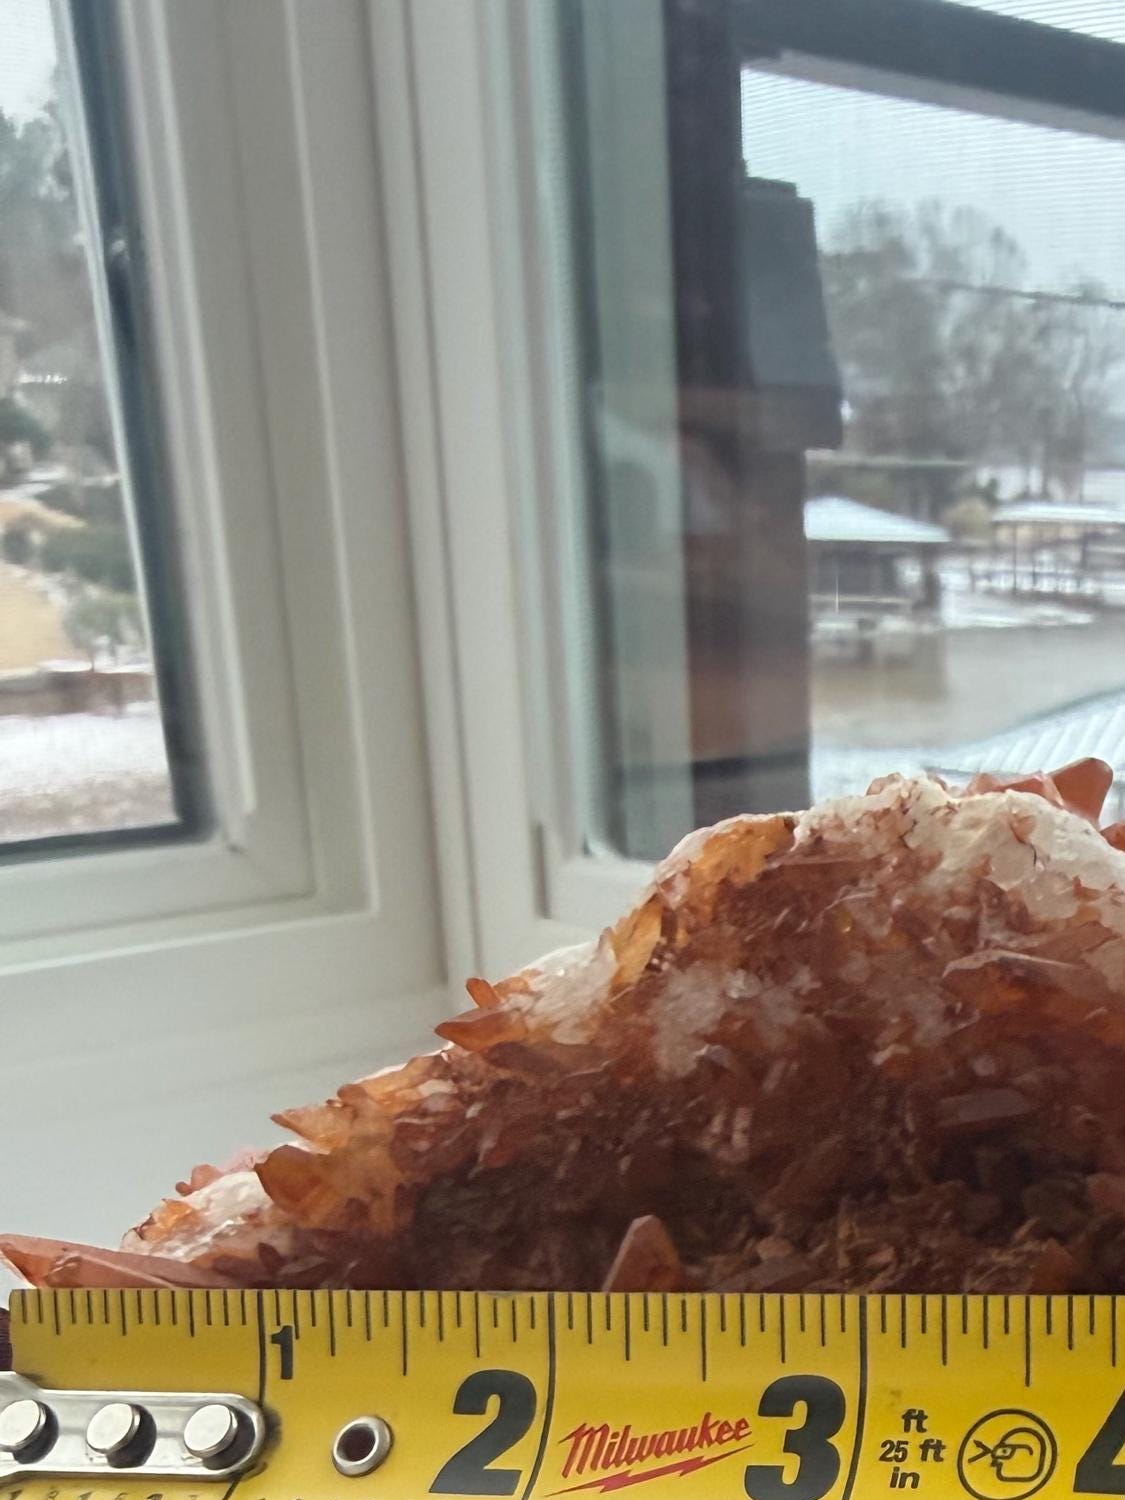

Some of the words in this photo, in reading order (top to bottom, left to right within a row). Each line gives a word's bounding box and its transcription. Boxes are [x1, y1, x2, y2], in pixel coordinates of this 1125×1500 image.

[271, 1325, 294, 1380] 1
[430, 1369, 537, 1496] 2
[902, 1409, 928, 1433] ft
[557, 1411, 752, 1480] Milwaukee
[879, 1439, 909, 1463] 25
[919, 1438, 946, 1462] ft
[889, 1467, 920, 1489] in
